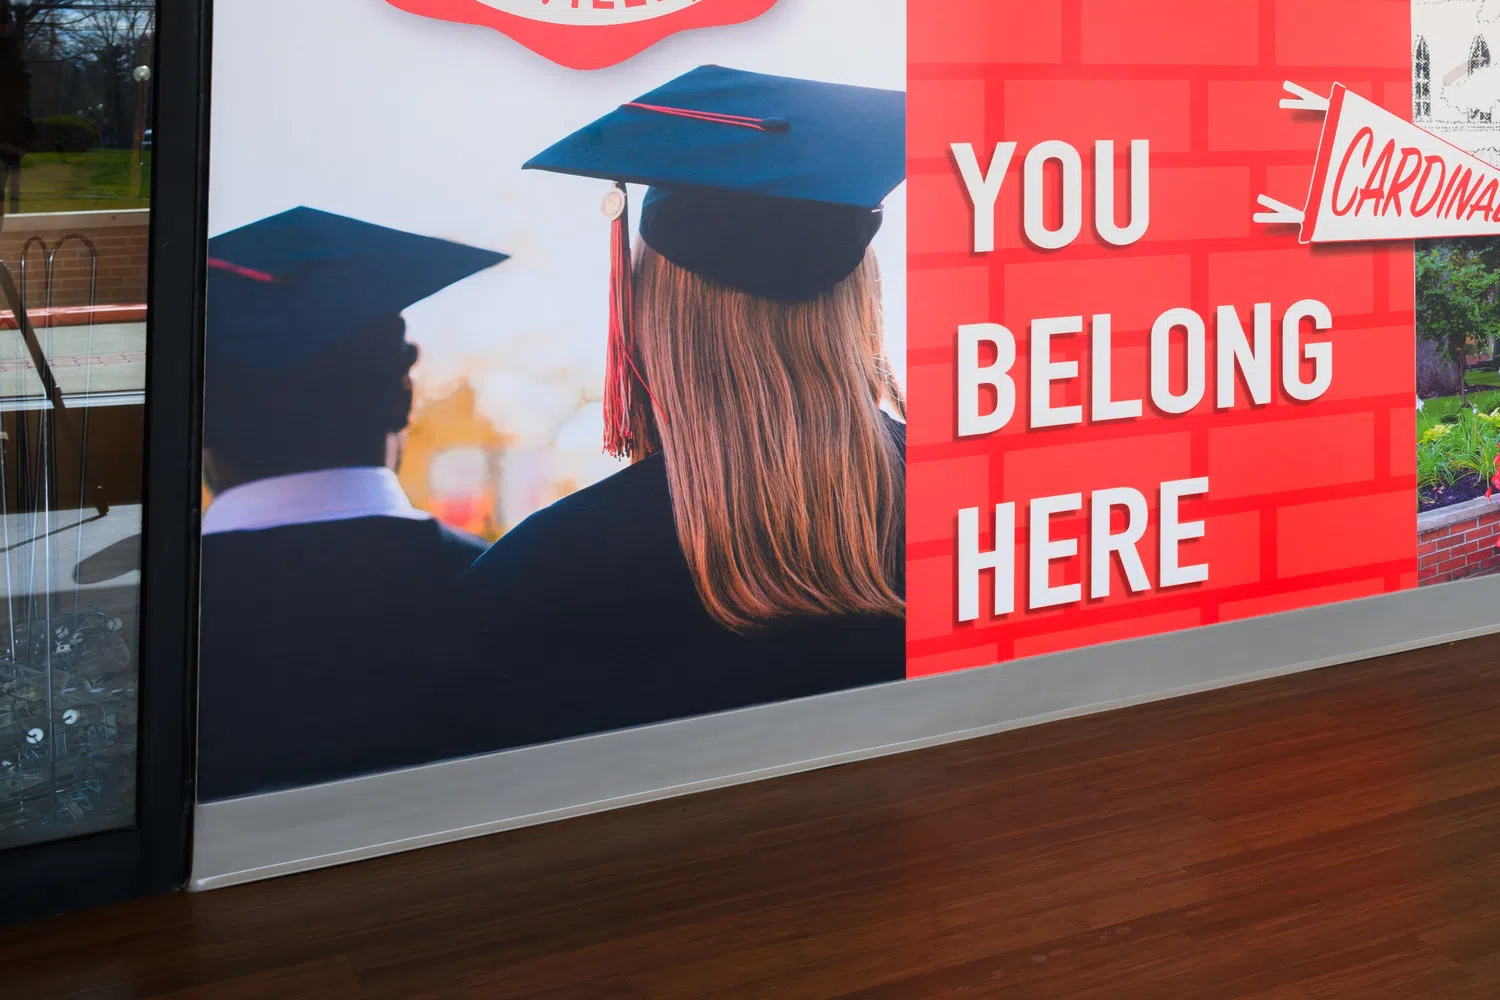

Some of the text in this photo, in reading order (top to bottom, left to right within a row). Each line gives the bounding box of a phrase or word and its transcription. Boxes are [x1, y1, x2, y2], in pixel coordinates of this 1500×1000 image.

[949, 139, 1150, 253] YOU
[957, 299, 1333, 437] BELONG
[957, 476, 1210, 622] HERE
